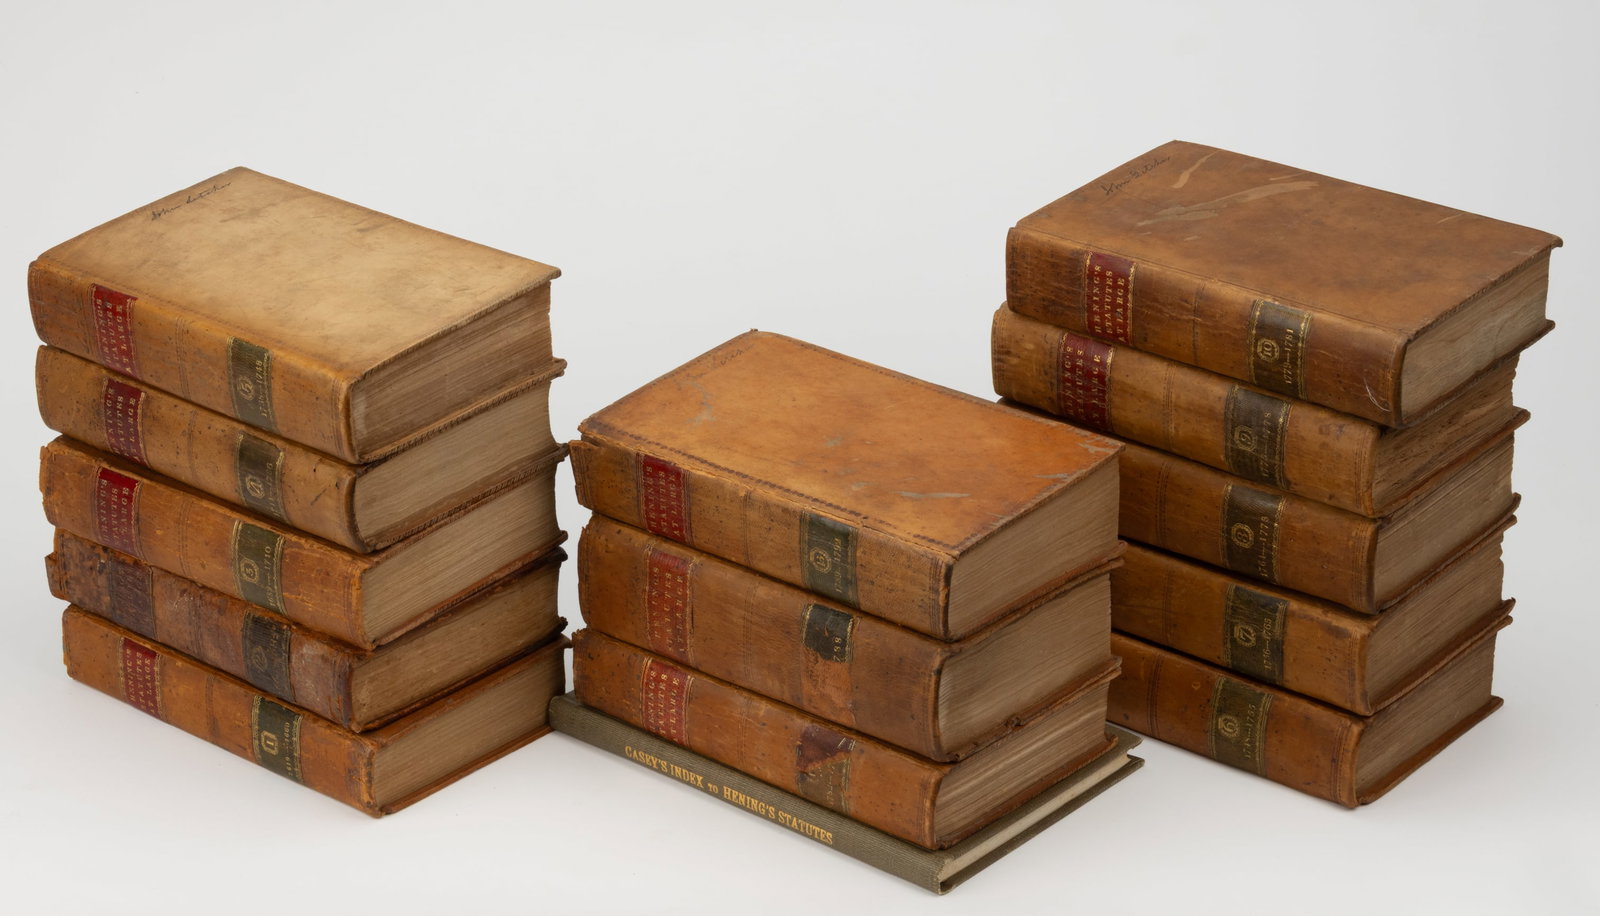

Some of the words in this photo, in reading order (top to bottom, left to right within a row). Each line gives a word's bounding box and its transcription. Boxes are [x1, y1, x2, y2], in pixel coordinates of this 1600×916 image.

[1093, 266, 1101, 333] HENING'S
[1116, 278, 1124, 323] LARGE
[116, 304, 128, 350] LARGE
[1117, 326, 1125, 342] AT
[1263, 342, 1272, 356] 10
[128, 398, 136, 442] LARGE
[100, 480, 109, 542] HENING'S
[646, 466, 656, 528] HENING'S
[659, 471, 667, 532] STATUTES
[672, 520, 680, 537] AT
[658, 674, 667, 735] TATUTES
[624, 746, 668, 773] CASEY'S
[670, 764, 704, 788] INDEX
[723, 786, 776, 819] HENING'S
[778, 811, 833, 845] STATUTES
